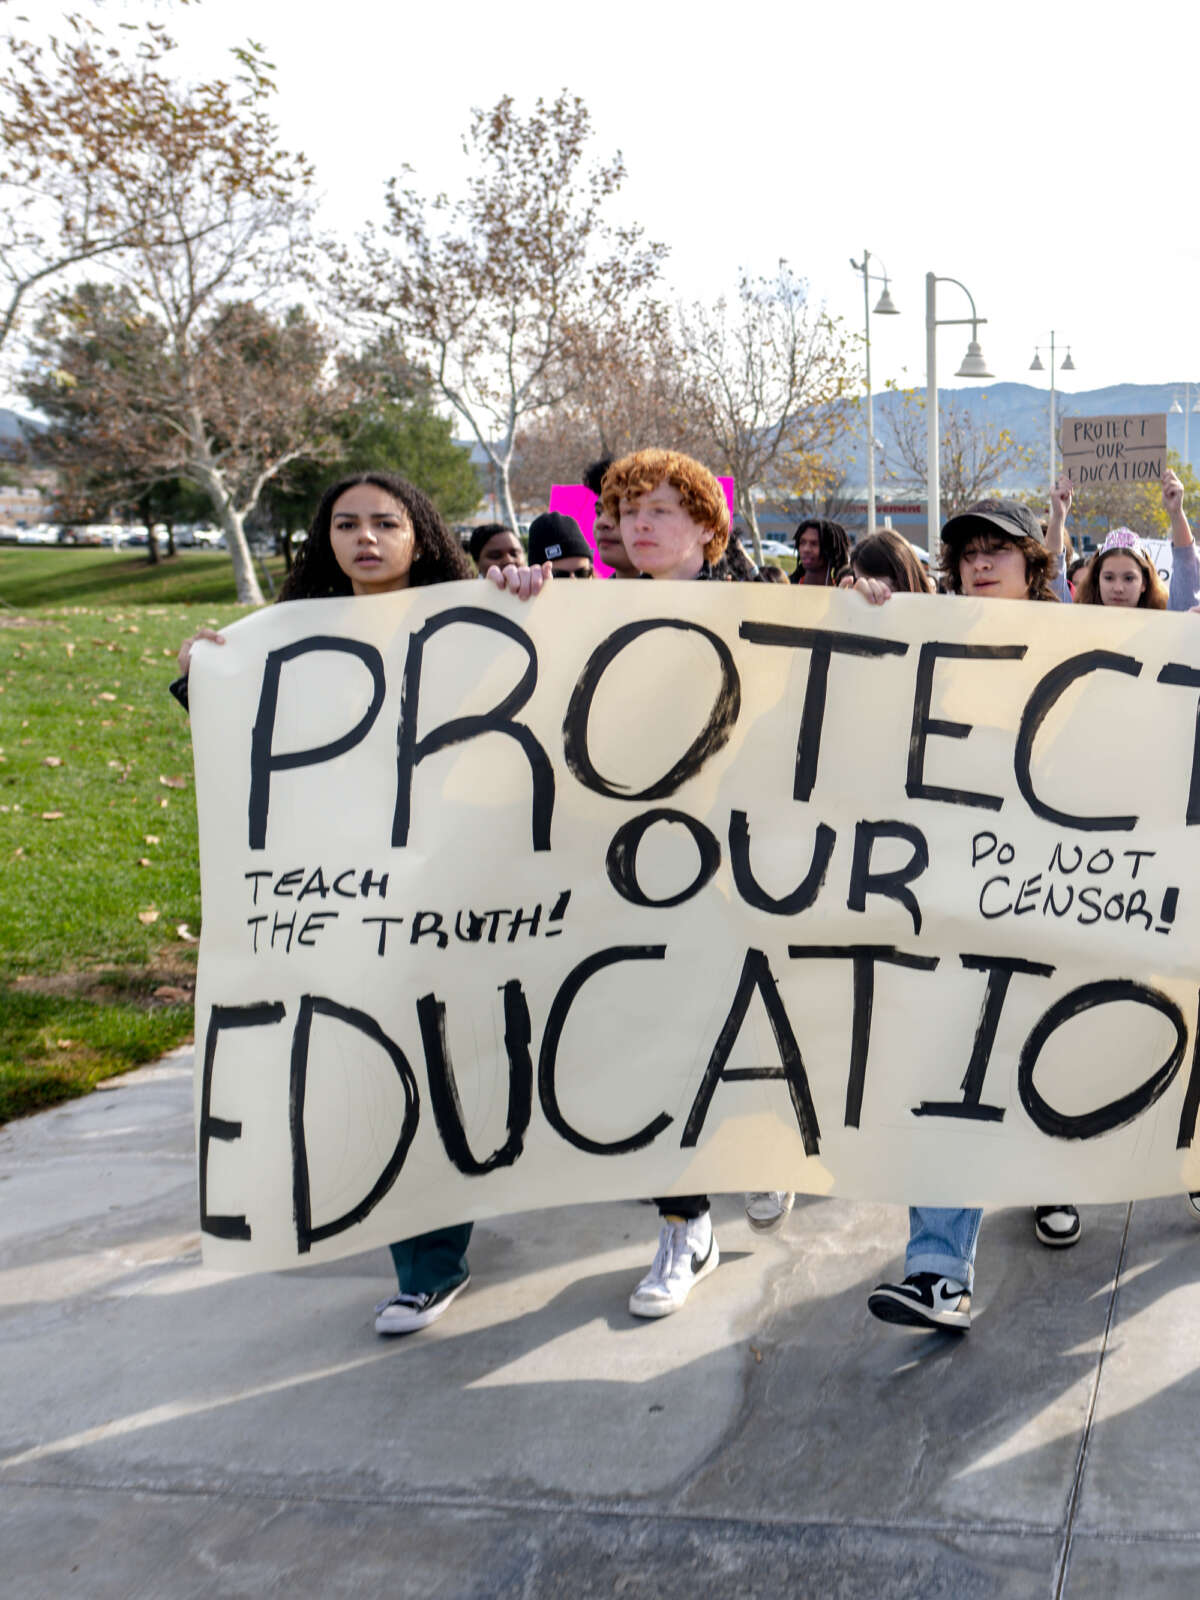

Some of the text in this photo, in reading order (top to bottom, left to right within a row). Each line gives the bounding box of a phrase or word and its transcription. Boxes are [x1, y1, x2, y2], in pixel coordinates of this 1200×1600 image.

[1073, 419, 1148, 442] PROTECT
[1095, 442, 1125, 459] OUR
[1068, 458, 1161, 484] EDUCATION
[605, 808, 929, 936] OUR
[1049, 843, 1156, 879] NOT
[244, 866, 389, 905] TEACH
[247, 889, 572, 956] THE TRUTH!
[979, 874, 1181, 935] CENSOR!
